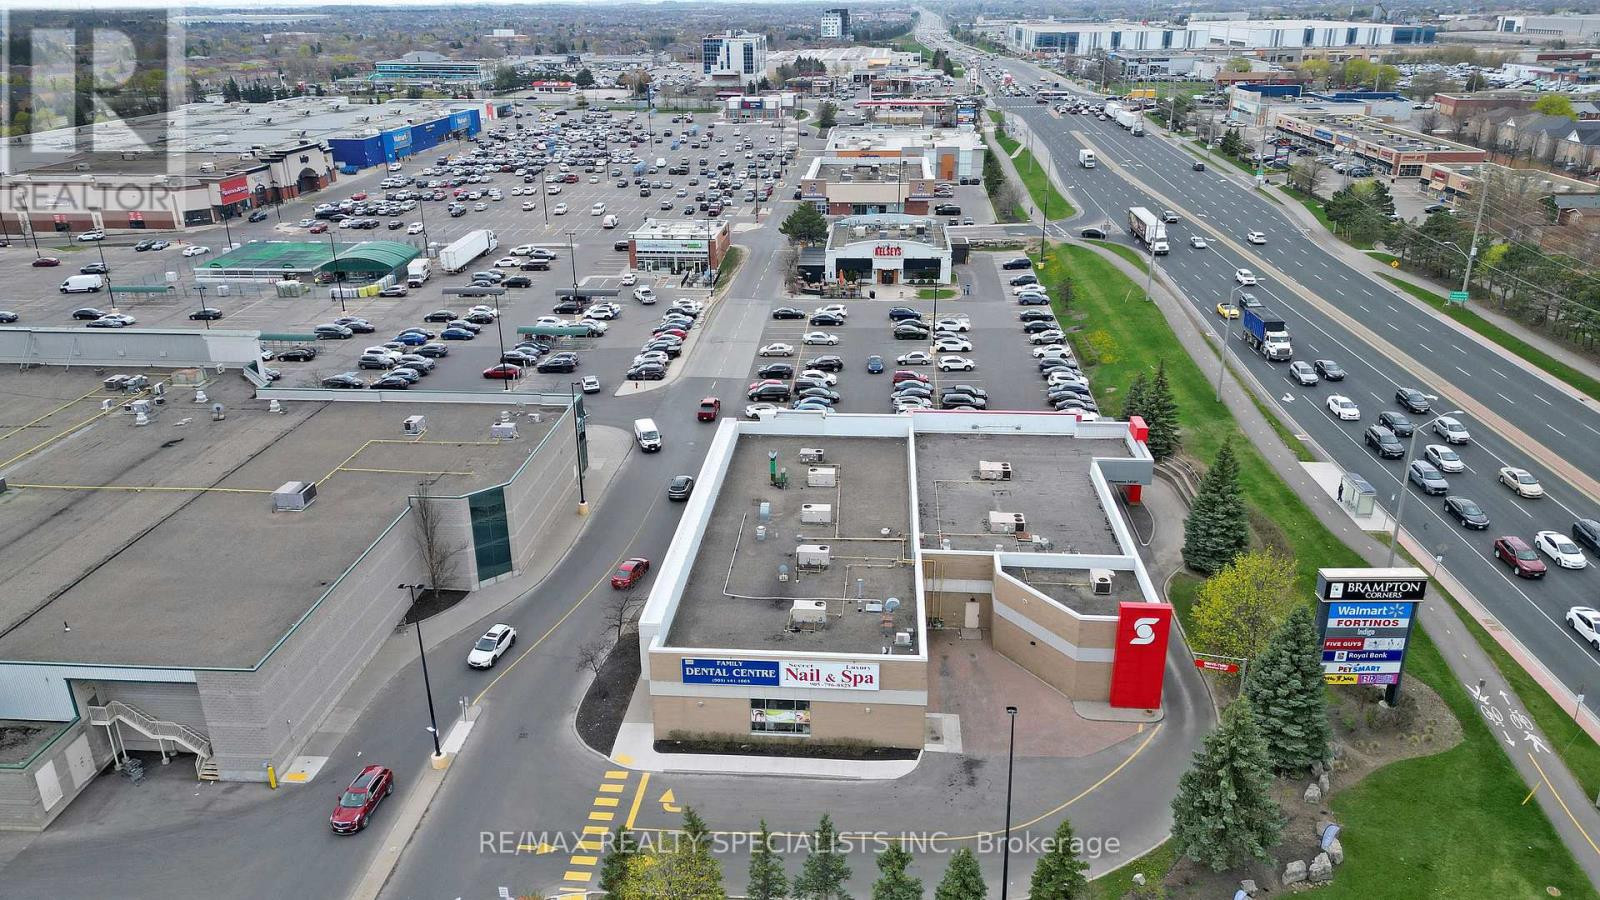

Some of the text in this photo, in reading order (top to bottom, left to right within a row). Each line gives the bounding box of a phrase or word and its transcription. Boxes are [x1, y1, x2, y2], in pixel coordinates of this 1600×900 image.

[1347, 582, 1421, 593] BRAMPTON
[1338, 606, 1388, 616] Walmart
[1357, 628, 1375, 636] Indigo
[1348, 652, 1368, 660] Royal
[686, 667, 776, 678] DENTAL CENTRE
[785, 667, 874, 687] Nail & Spa
